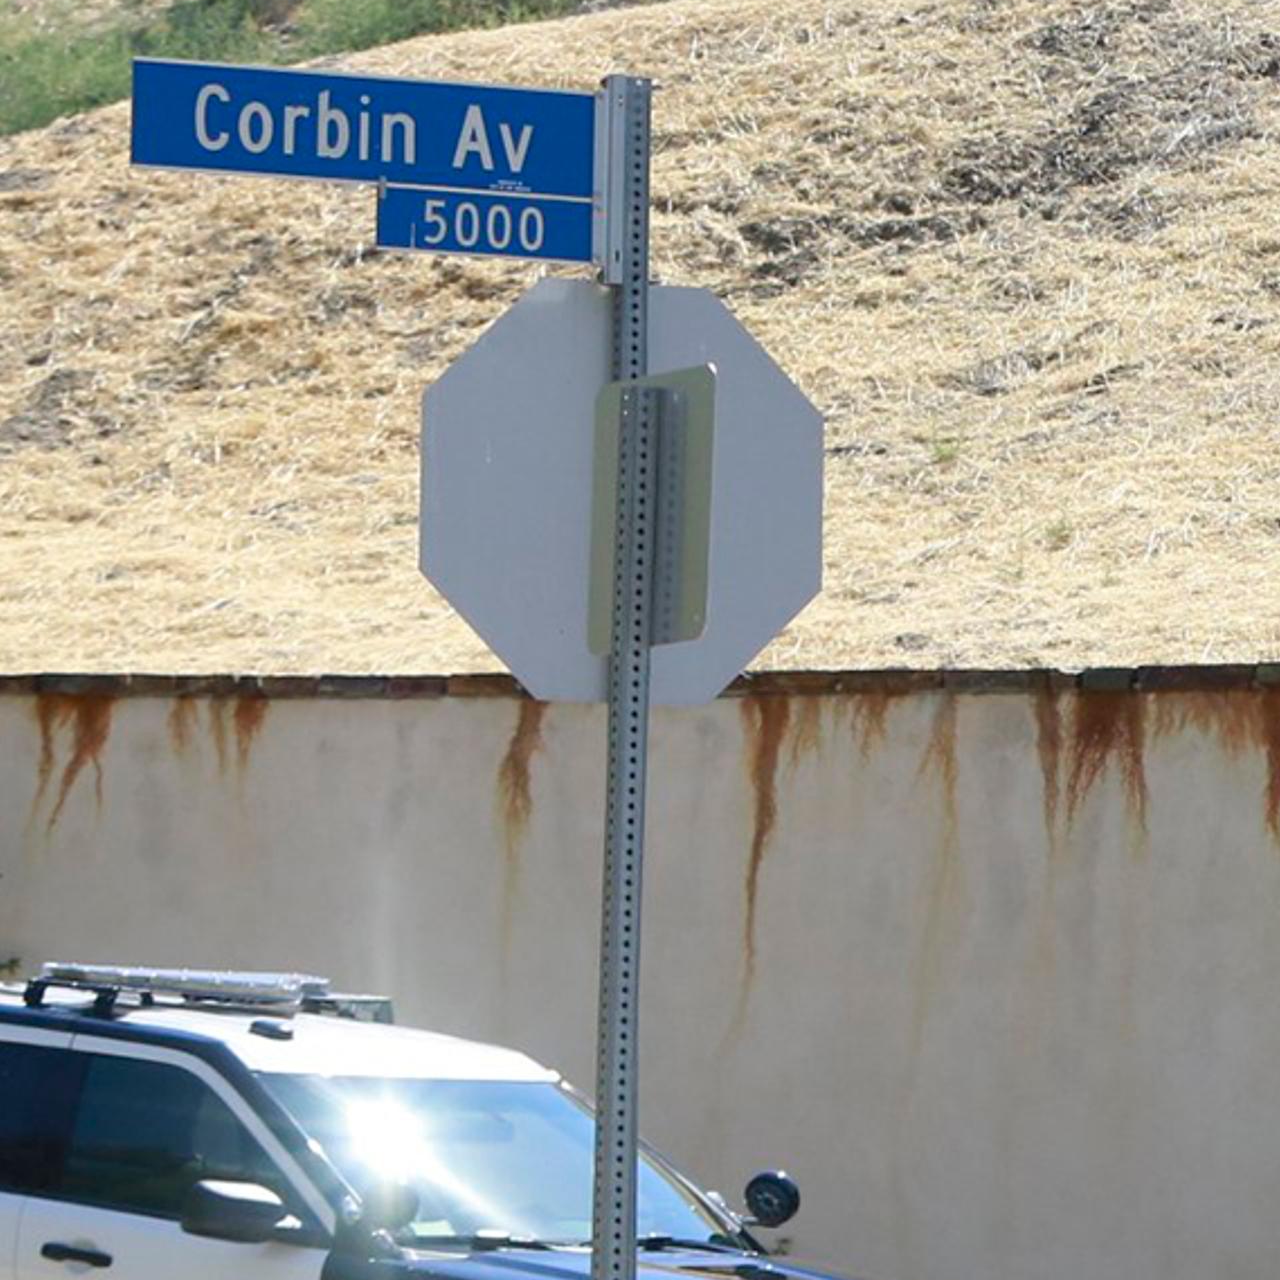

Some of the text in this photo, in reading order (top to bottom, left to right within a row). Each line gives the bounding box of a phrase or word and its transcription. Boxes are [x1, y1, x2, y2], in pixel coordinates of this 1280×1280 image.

[194, 84, 533, 174] Corbin Av
[423, 200, 544, 251] 5000
